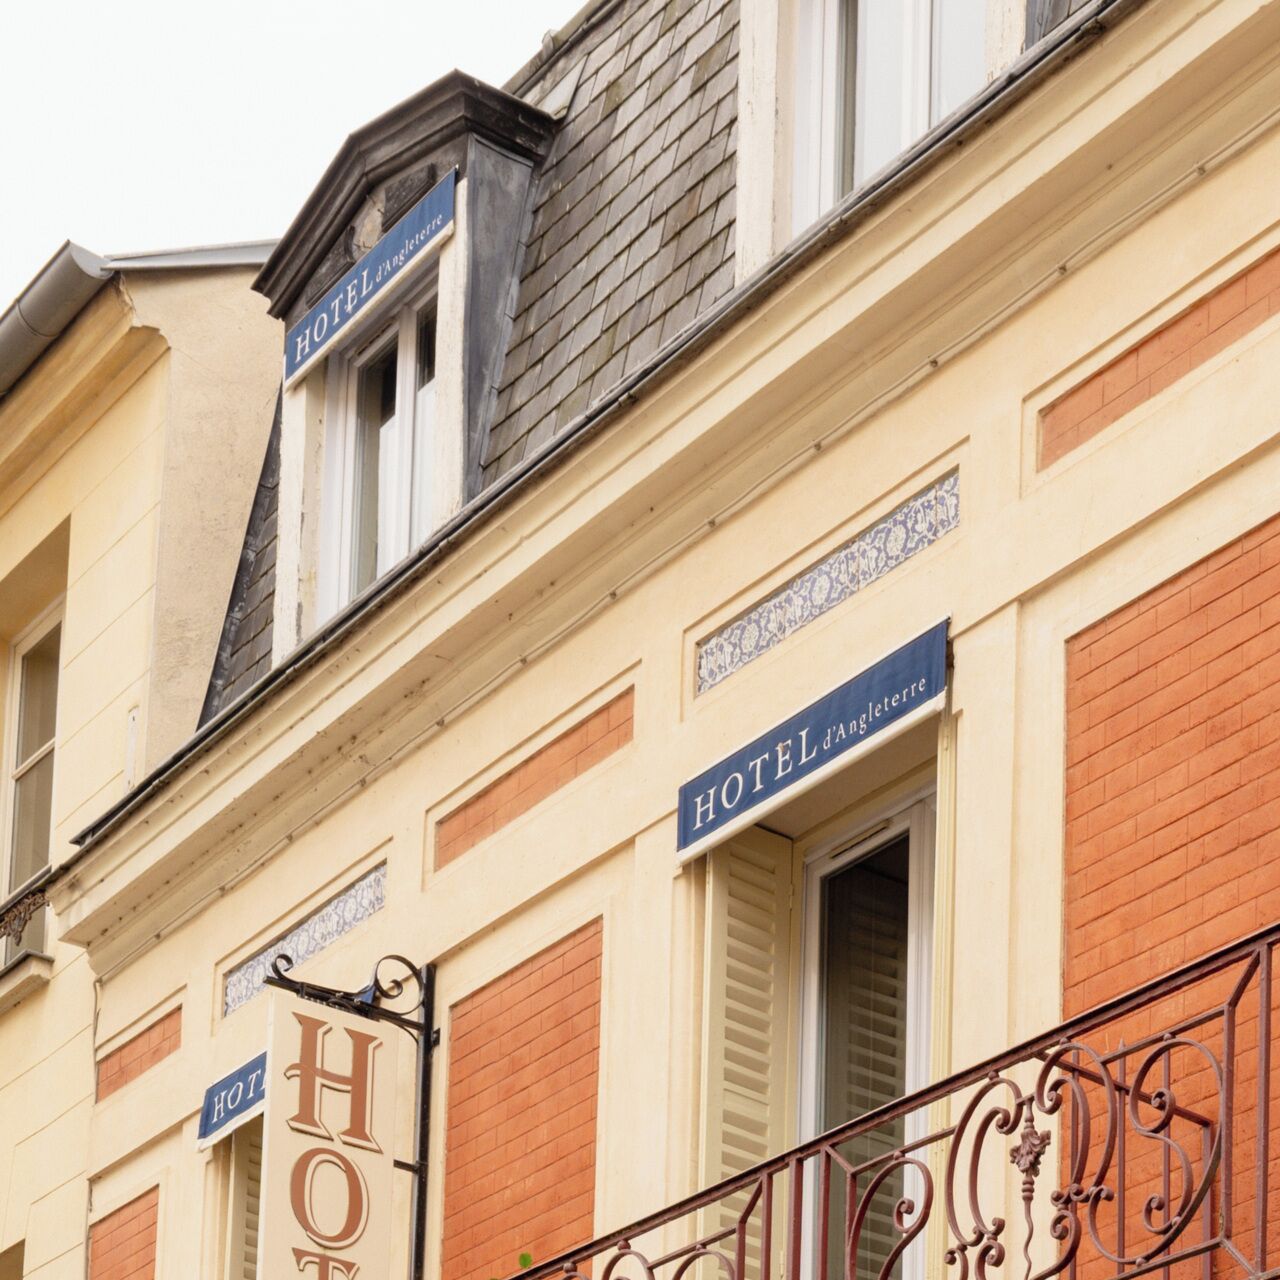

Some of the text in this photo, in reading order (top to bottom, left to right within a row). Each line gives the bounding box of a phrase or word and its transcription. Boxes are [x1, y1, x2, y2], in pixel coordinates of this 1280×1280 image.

[294, 214, 443, 364] HOTEL d'Angleterre
[693, 677, 926, 831] HOTEL d'Angleterre
[211, 1068, 266, 1124] HOT
